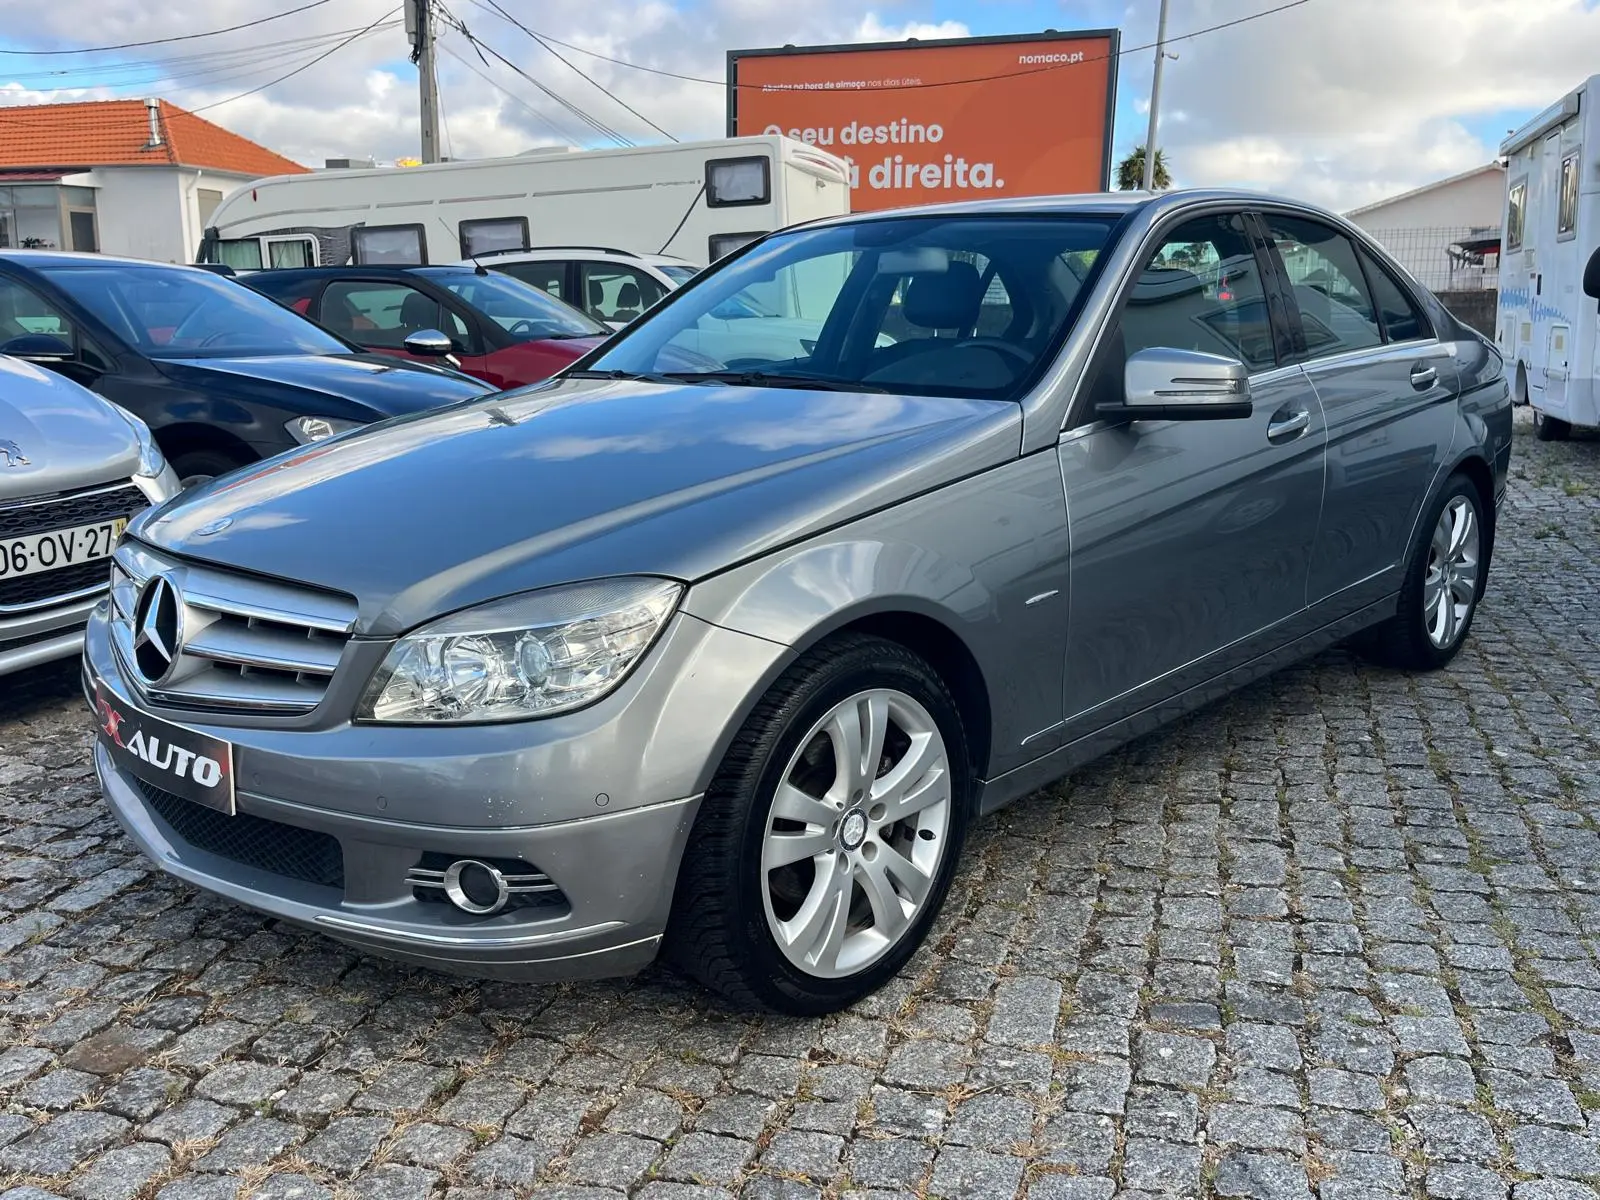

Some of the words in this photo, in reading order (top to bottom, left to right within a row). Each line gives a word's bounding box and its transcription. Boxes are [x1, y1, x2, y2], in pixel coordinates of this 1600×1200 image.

[1018, 51, 1083, 64] nomaco.pt
[804, 82, 823, 90] hora
[824, 81, 835, 89] de
[835, 79, 866, 90] almoço
[883, 78, 900, 87] dias
[788, 127, 834, 146] seu
[840, 118, 944, 145] destino
[868, 154, 1005, 189] direita.
[126, 729, 223, 788] AUTO
